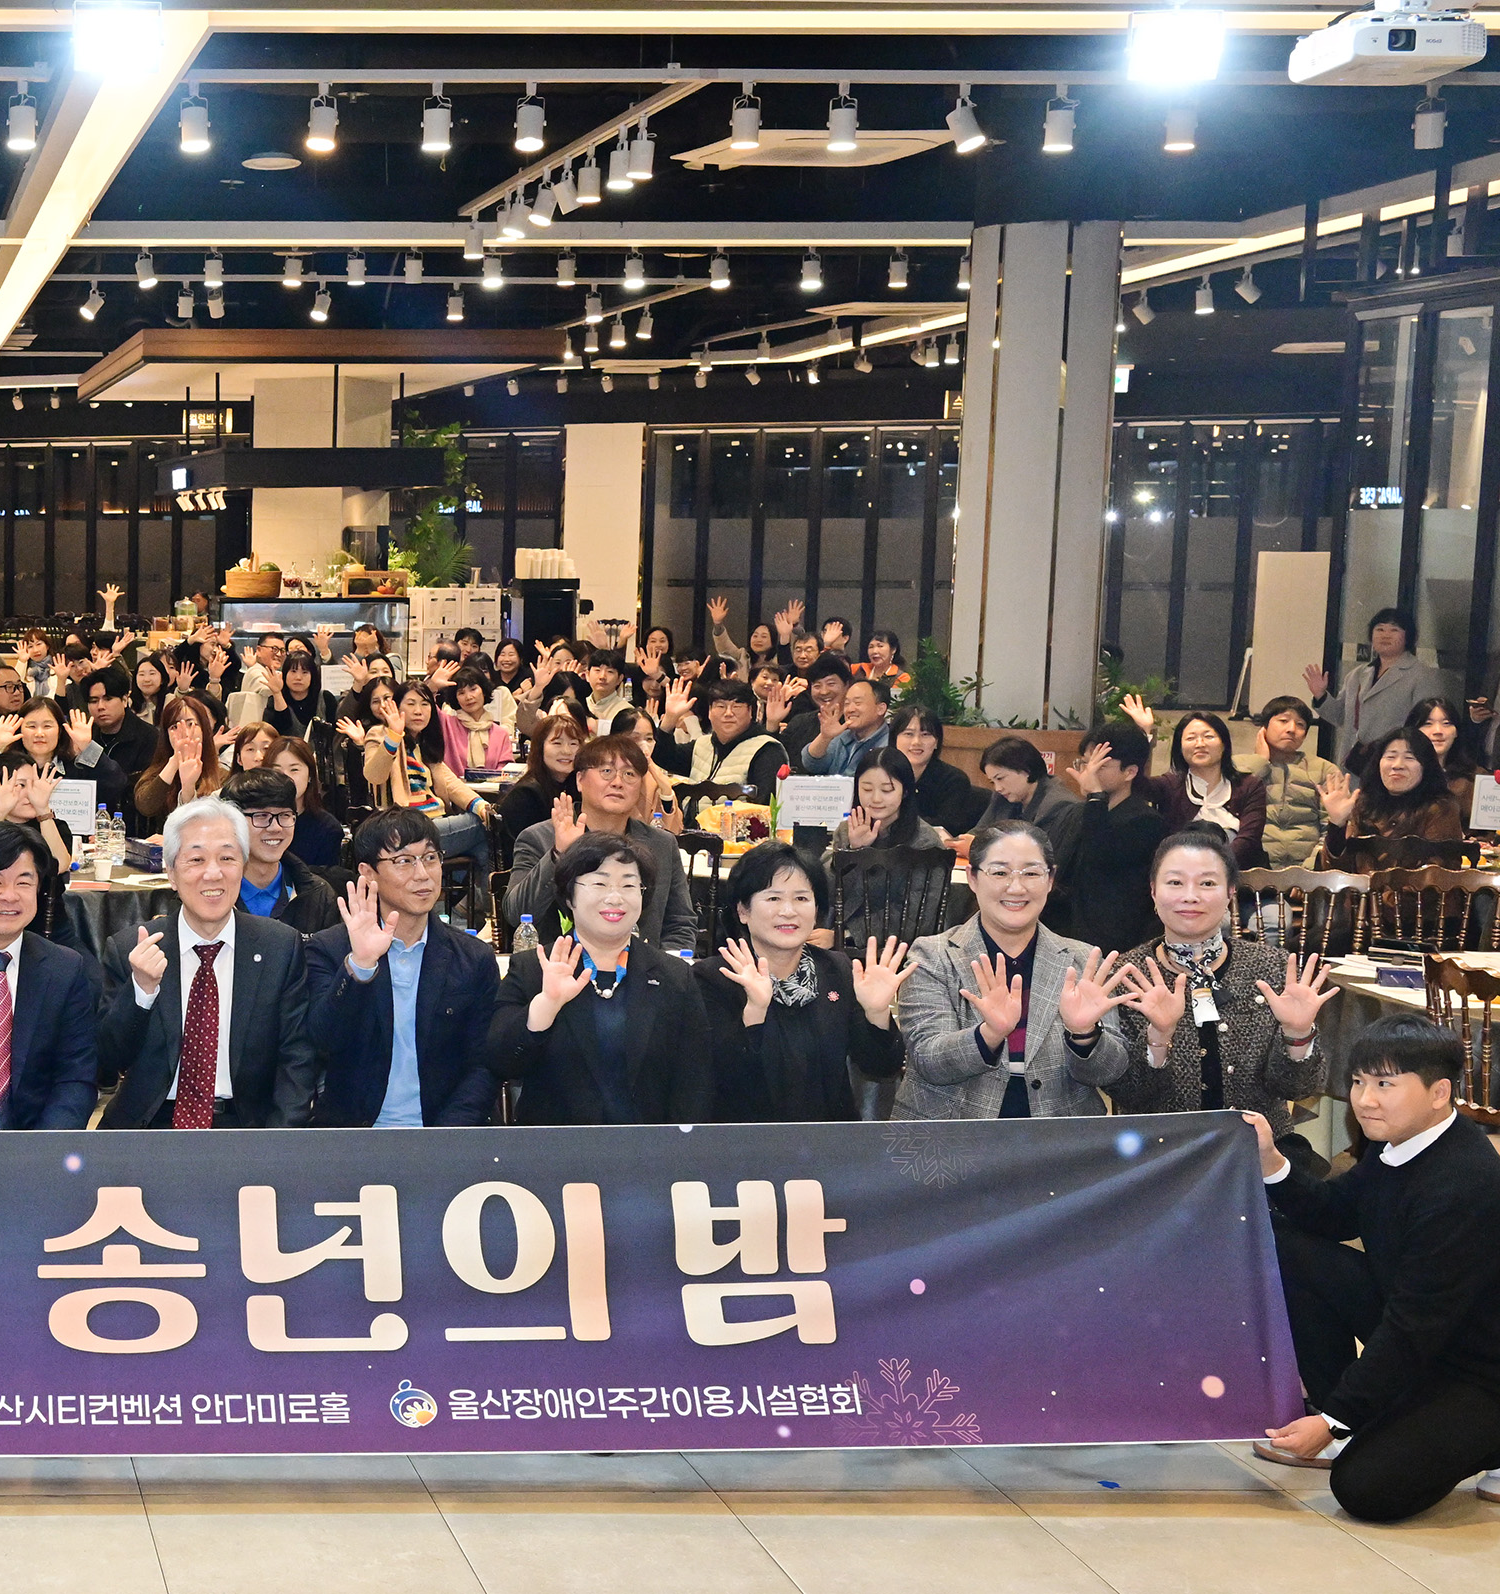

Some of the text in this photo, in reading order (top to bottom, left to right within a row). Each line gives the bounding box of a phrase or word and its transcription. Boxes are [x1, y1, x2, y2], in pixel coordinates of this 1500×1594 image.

[37, 1179, 847, 1353] 송년의 밤
[192, 1392, 351, 1425] 안다미로홀
[448, 1383, 864, 1421] 울산장애인주간이용시설협회
